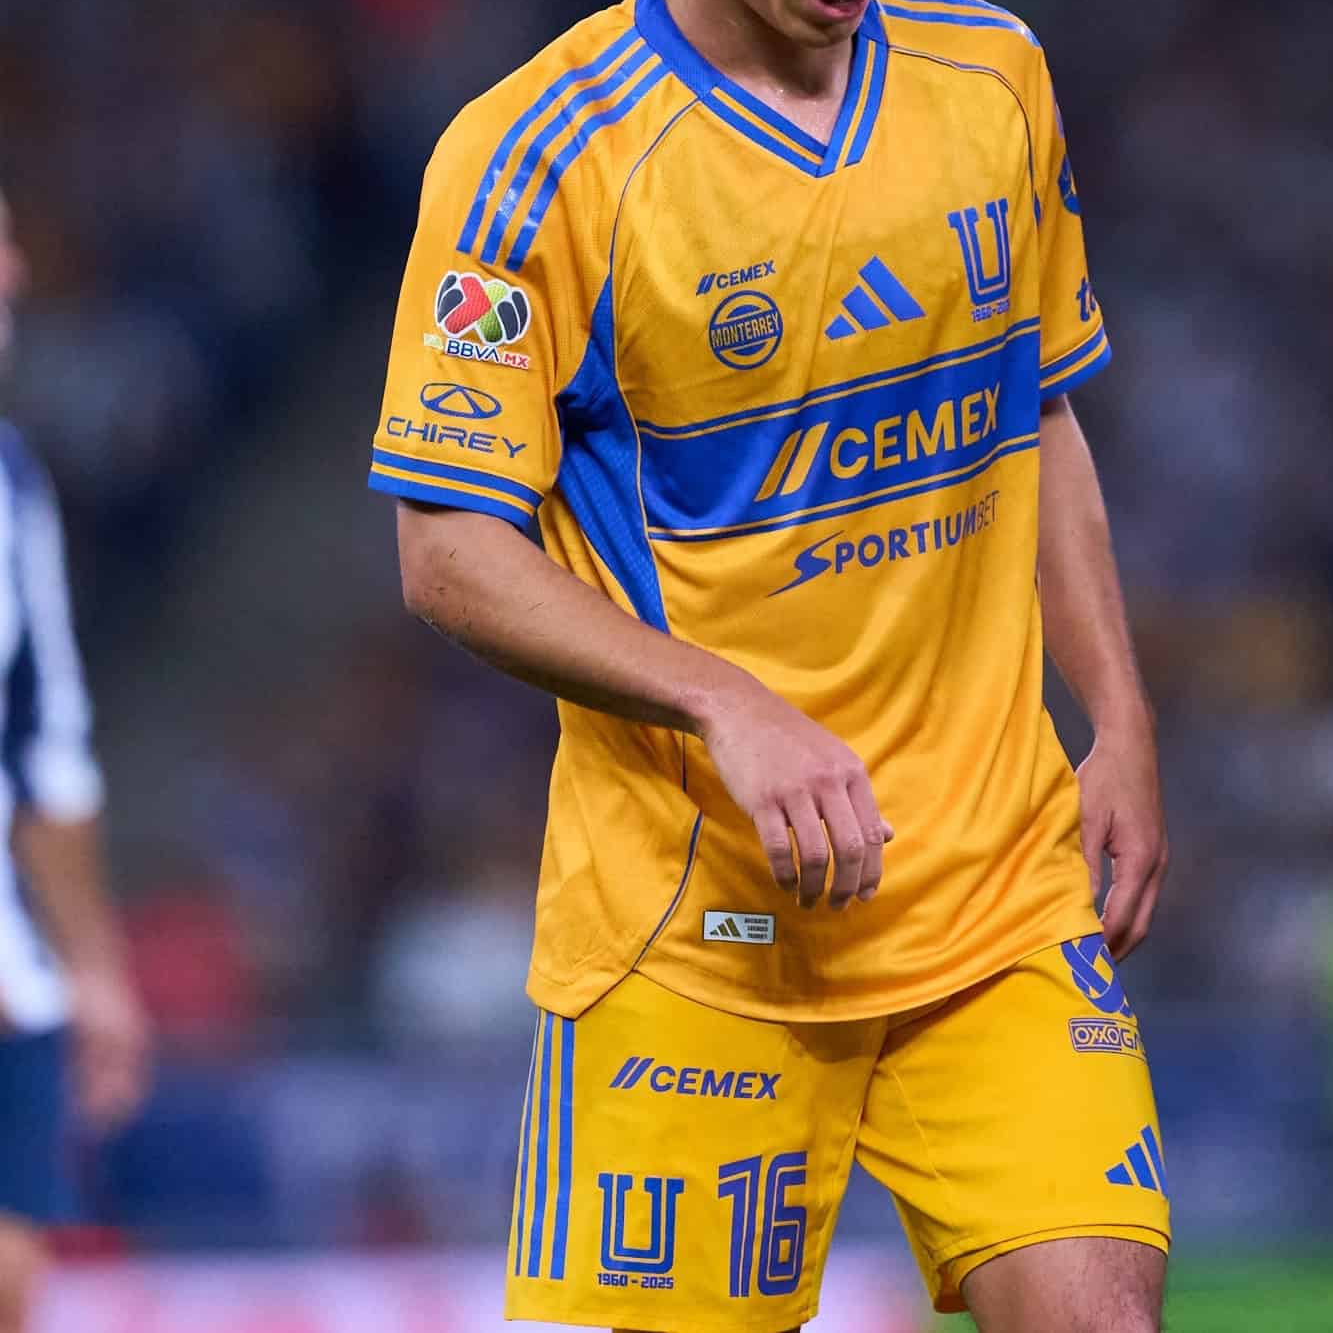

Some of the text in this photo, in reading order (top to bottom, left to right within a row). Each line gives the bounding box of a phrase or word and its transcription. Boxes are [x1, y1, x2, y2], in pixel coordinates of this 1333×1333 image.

[716, 259, 776, 289] CEMEX
[711, 312, 780, 348] MONTERREY
[447, 339, 500, 363] BBVA
[502, 353, 529, 369] MX
[386, 416, 528, 459] CHIREY
[829, 380, 1001, 480] CEMEX
[650, 1065, 782, 1100] CEMEX
[718, 1150, 807, 1298] 16
